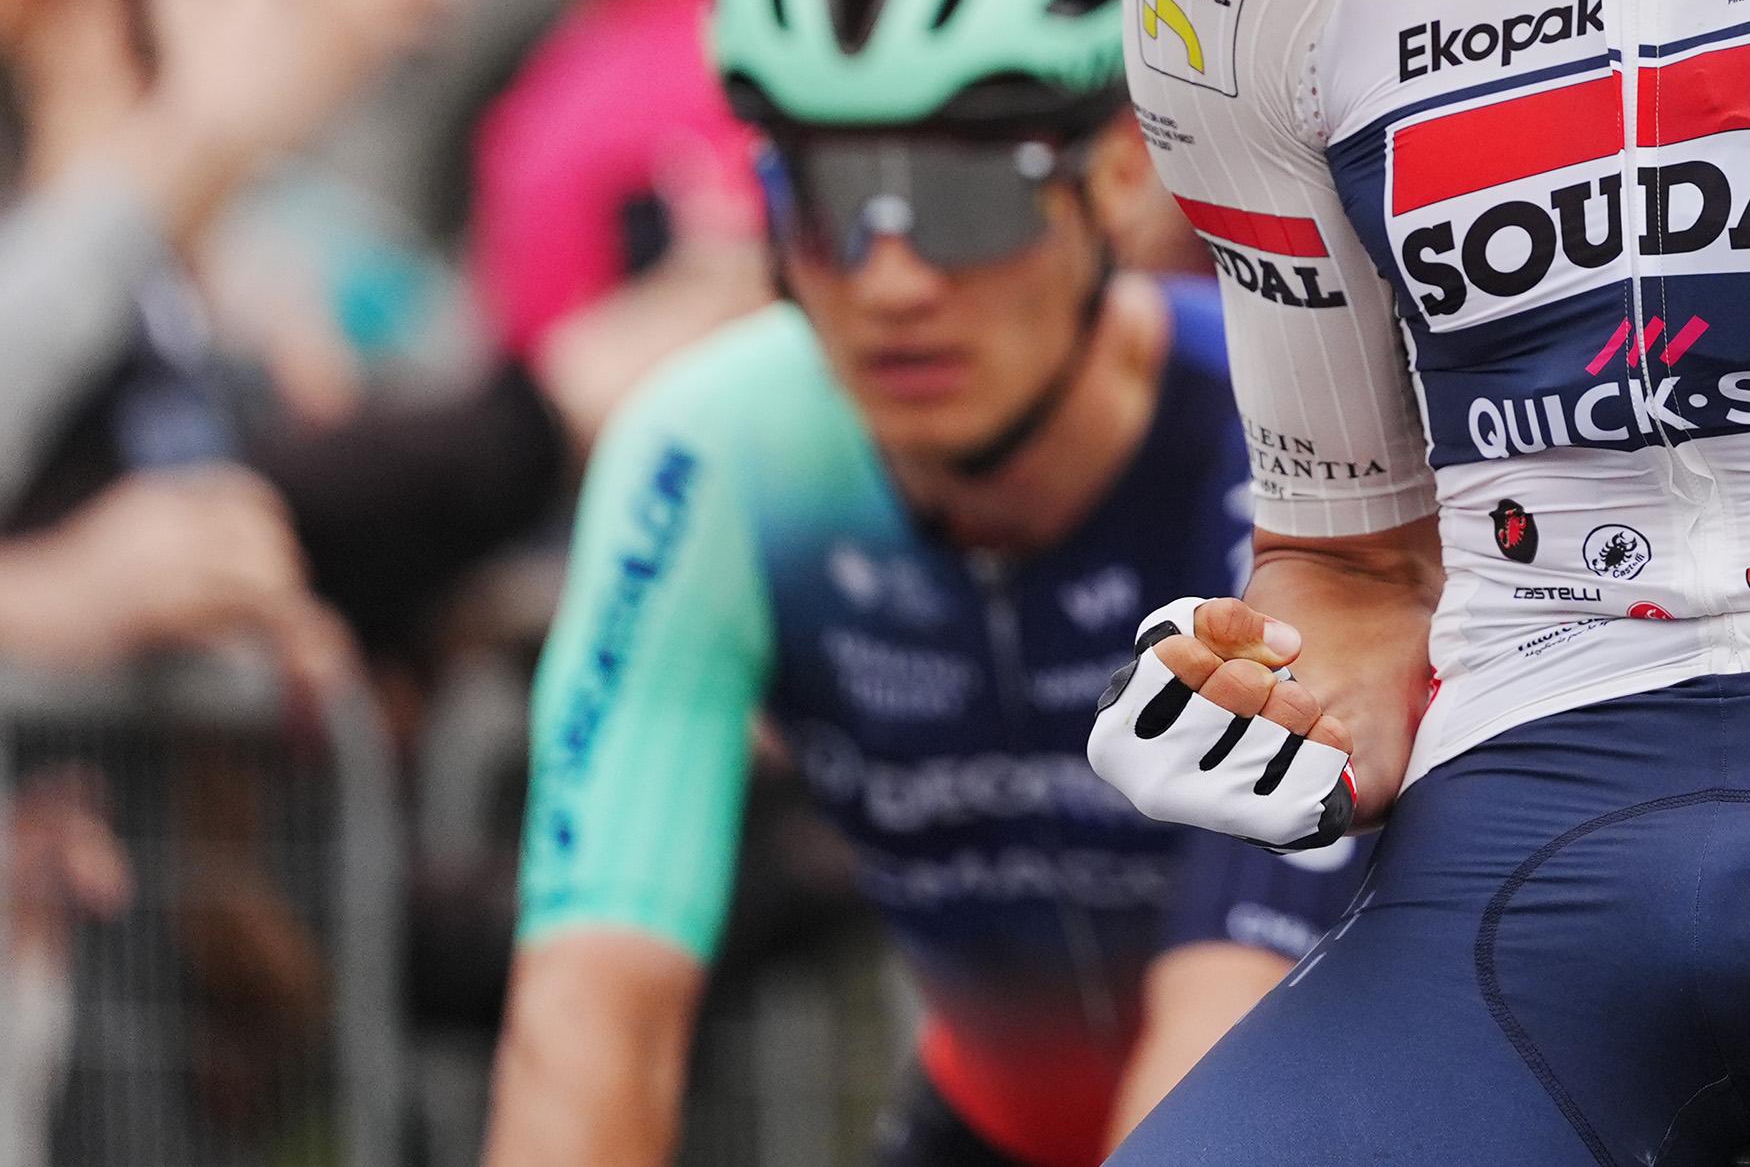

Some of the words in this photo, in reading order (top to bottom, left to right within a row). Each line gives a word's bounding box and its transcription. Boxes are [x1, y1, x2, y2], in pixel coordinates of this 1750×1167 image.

[1248, 420, 1315, 455] LEIN
[1253, 447, 1387, 480] TANTIA
[1613, 553, 1645, 578] Castelli
